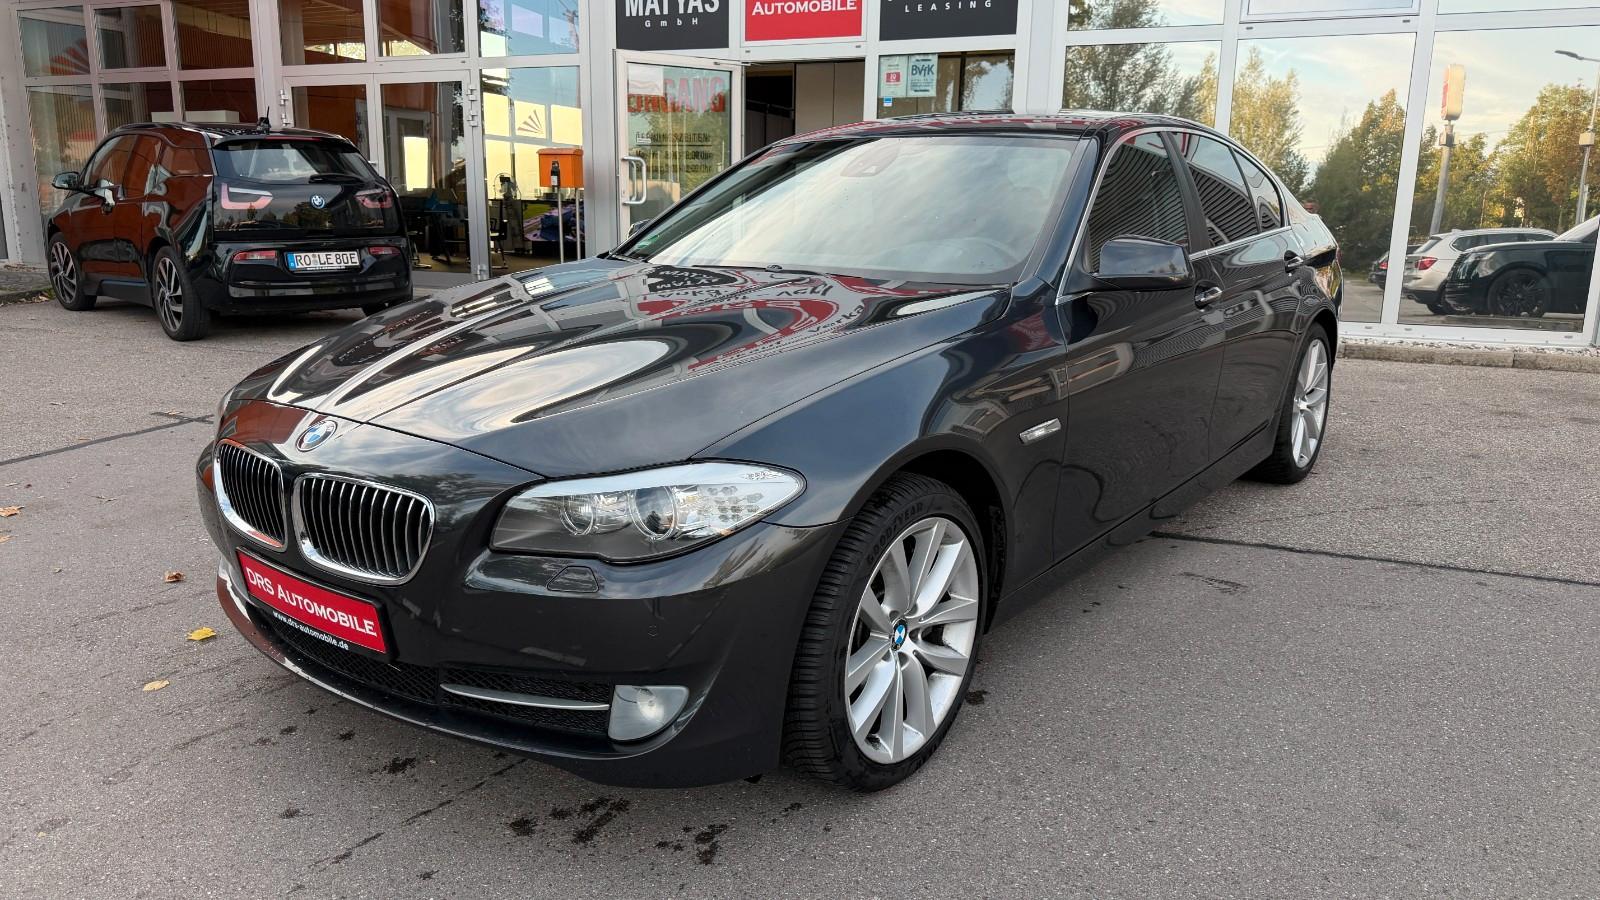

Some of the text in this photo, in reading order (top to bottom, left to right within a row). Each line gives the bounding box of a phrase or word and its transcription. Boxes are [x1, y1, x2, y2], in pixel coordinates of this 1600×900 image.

[752, 0, 857, 15] AUTOMOBILE
[904, 0, 992, 12] LEASING
[295, 254, 311, 266] RO
[245, 566, 378, 637] DRS AUTOMOBILE
[272, 610, 349, 651] www.drs-automobile.de
